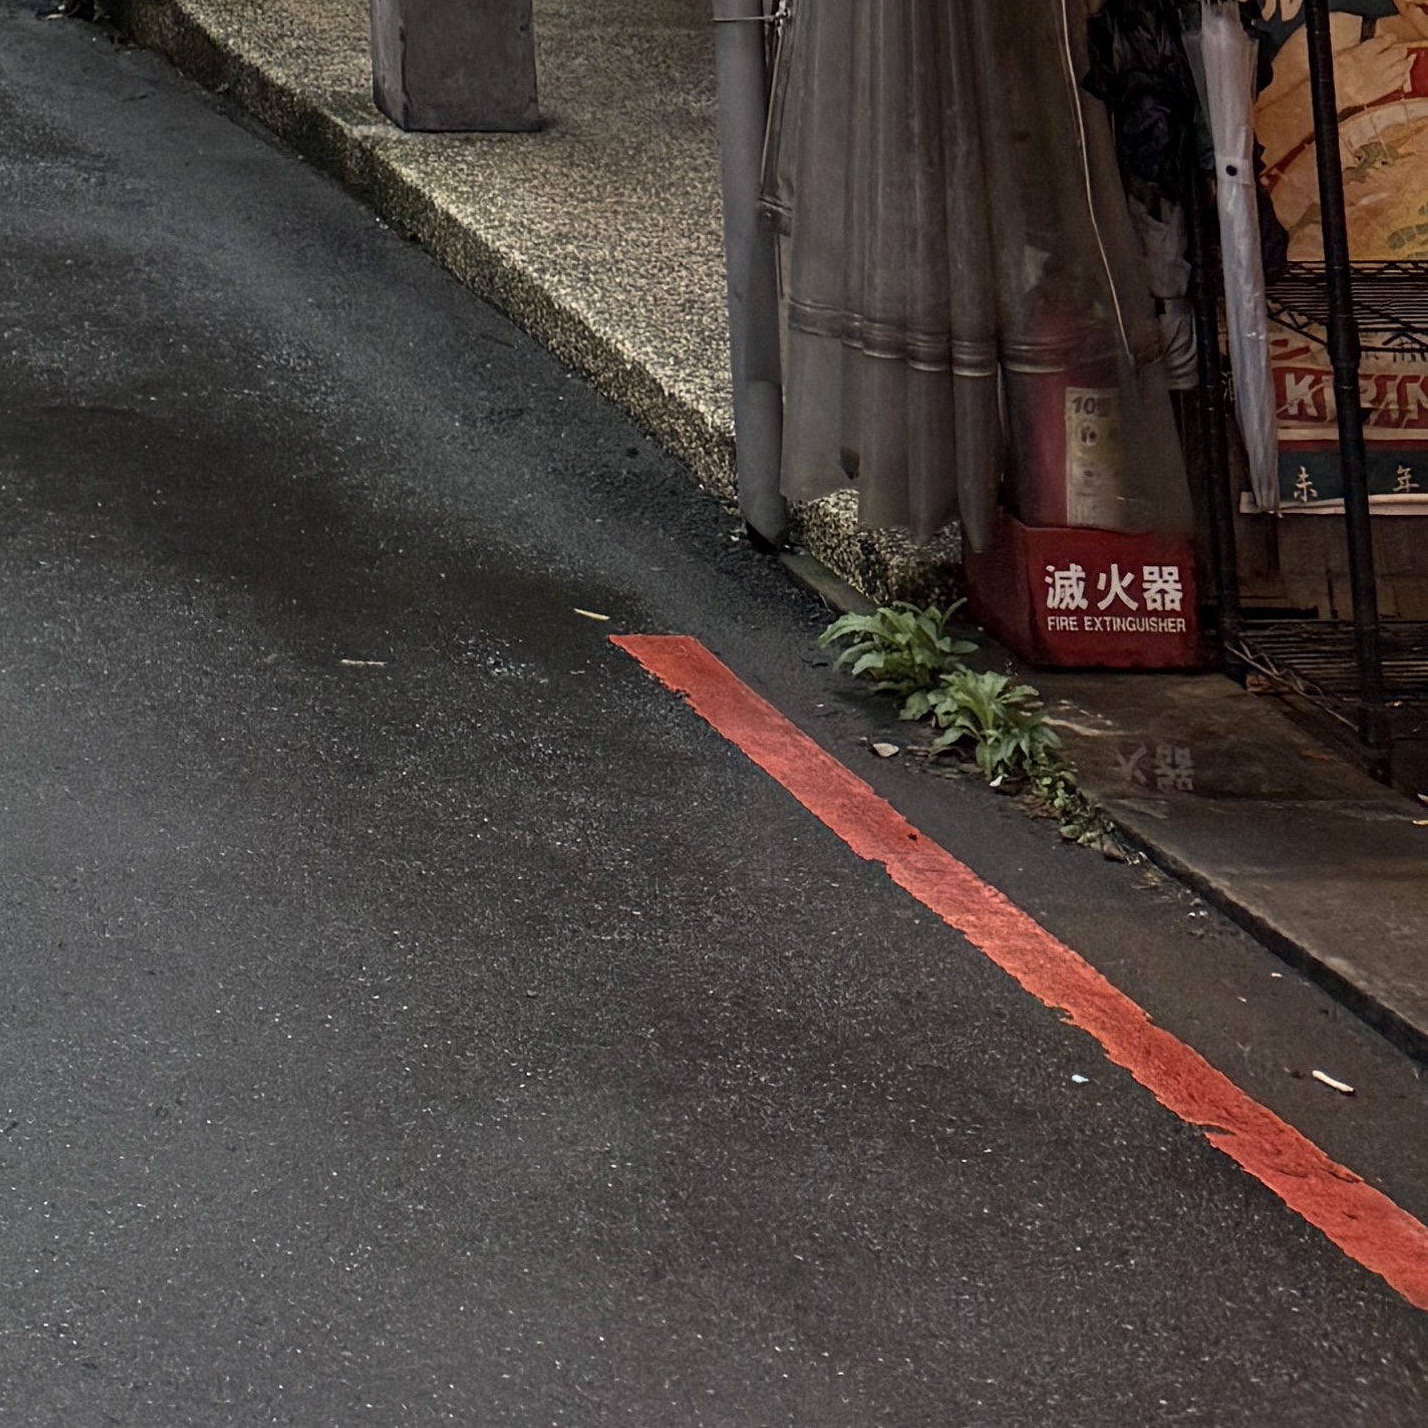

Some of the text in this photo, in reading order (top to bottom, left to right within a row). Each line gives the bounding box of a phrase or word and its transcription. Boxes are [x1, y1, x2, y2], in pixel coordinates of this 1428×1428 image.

[1045, 563, 1183, 612] 滅火器
[1047, 616, 1186, 634] FIRE EXTINGUISHER
